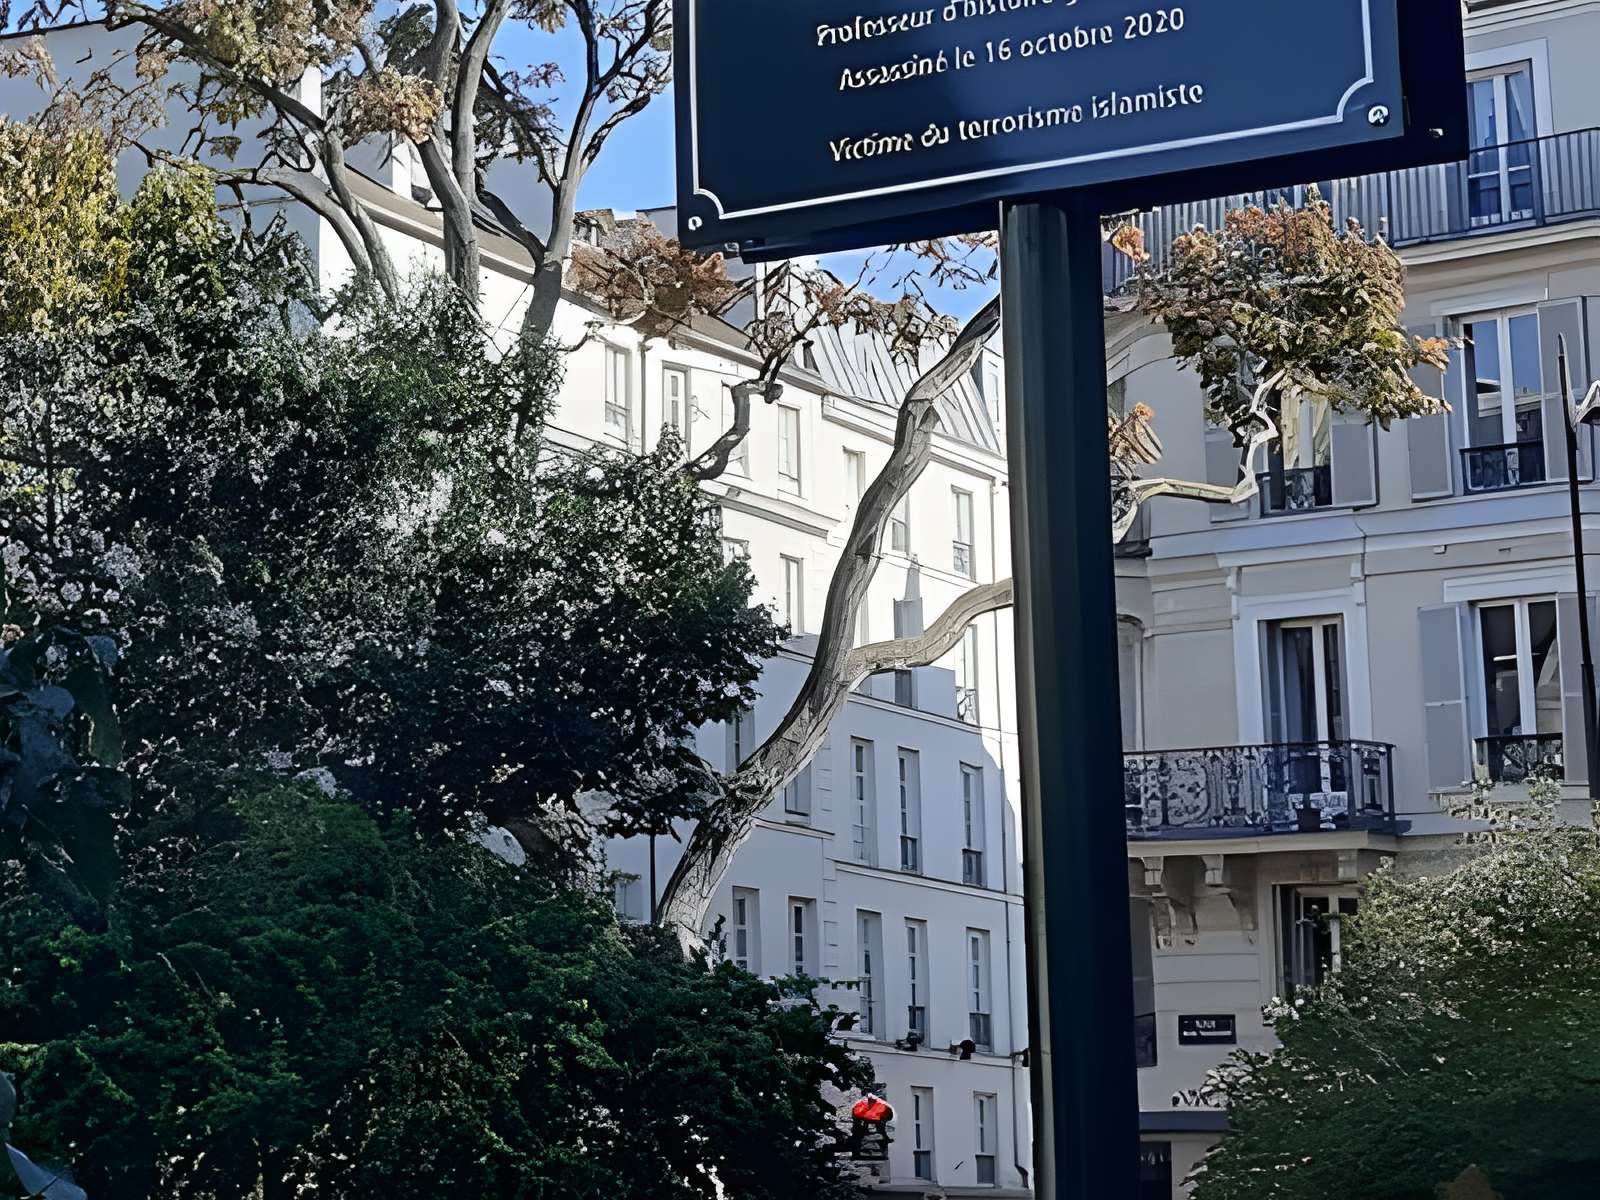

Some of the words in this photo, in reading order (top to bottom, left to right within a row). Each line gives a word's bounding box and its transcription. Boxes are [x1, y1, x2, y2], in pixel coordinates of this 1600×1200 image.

[954, 46, 976, 71] le
[985, 37, 1013, 64] 16
[1019, 24, 1114, 58] octobre
[1123, 6, 1185, 41] 2020
[919, 122, 951, 149] du
[957, 103, 1083, 142] terrorisme
[1091, 83, 1204, 120] islamiste
